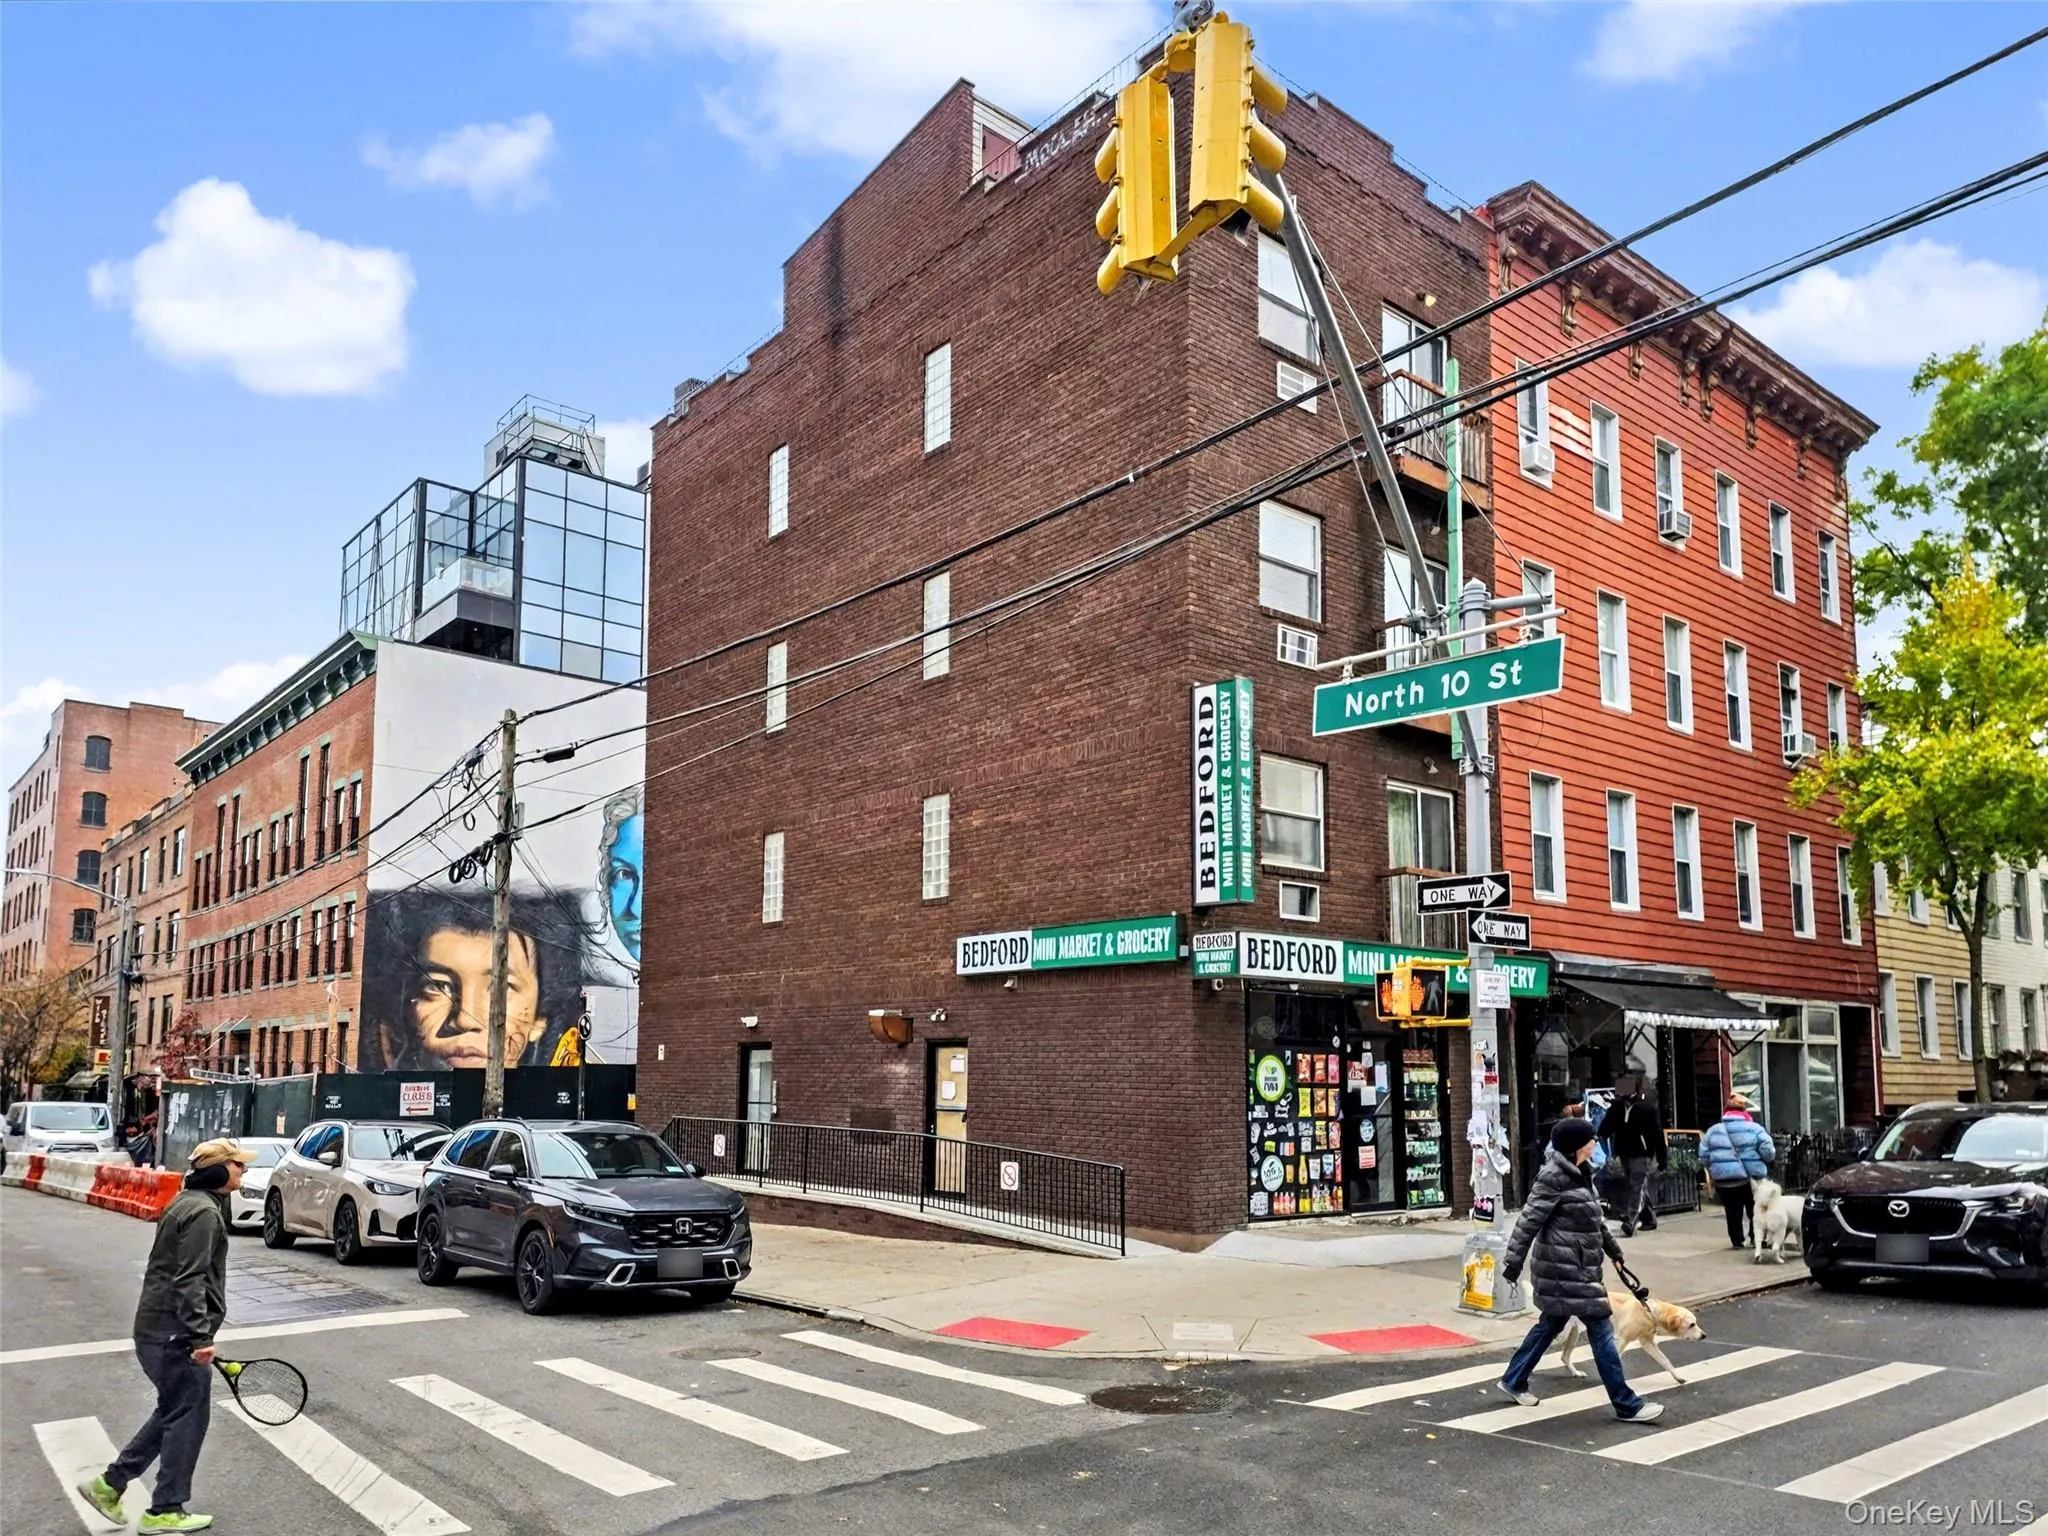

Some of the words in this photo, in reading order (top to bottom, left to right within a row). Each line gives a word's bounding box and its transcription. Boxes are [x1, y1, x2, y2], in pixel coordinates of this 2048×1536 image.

[1345, 681, 1424, 717] North
[1441, 670, 1470, 698] 10
[1488, 659, 1523, 690] St
[1220, 690, 1232, 761] GROCERY
[1239, 689, 1251, 762] GROCERY
[1198, 696, 1216, 890] BEDFORD
[1221, 766, 1232, 778] &
[1221, 783, 1233, 847] MARKET
[1240, 783, 1252, 847] MARKET
[1222, 851, 1234, 888] MINI
[1241, 852, 1252, 888] MINI
[1430, 888, 1456, 903] ONE
[1468, 884, 1496, 900] WAY
[962, 936, 1029, 968] BEDFORD
[1033, 938, 1056, 962] MINI
[1058, 932, 1103, 960] MARKET
[1105, 932, 1114, 956] &
[1117, 926, 1171, 955] GROCERY
[1477, 920, 1496, 936] ONE
[1503, 924, 1523, 938] WAY
[1246, 937, 1338, 975] BEDFORD
[1348, 949, 1385, 977] MINI
